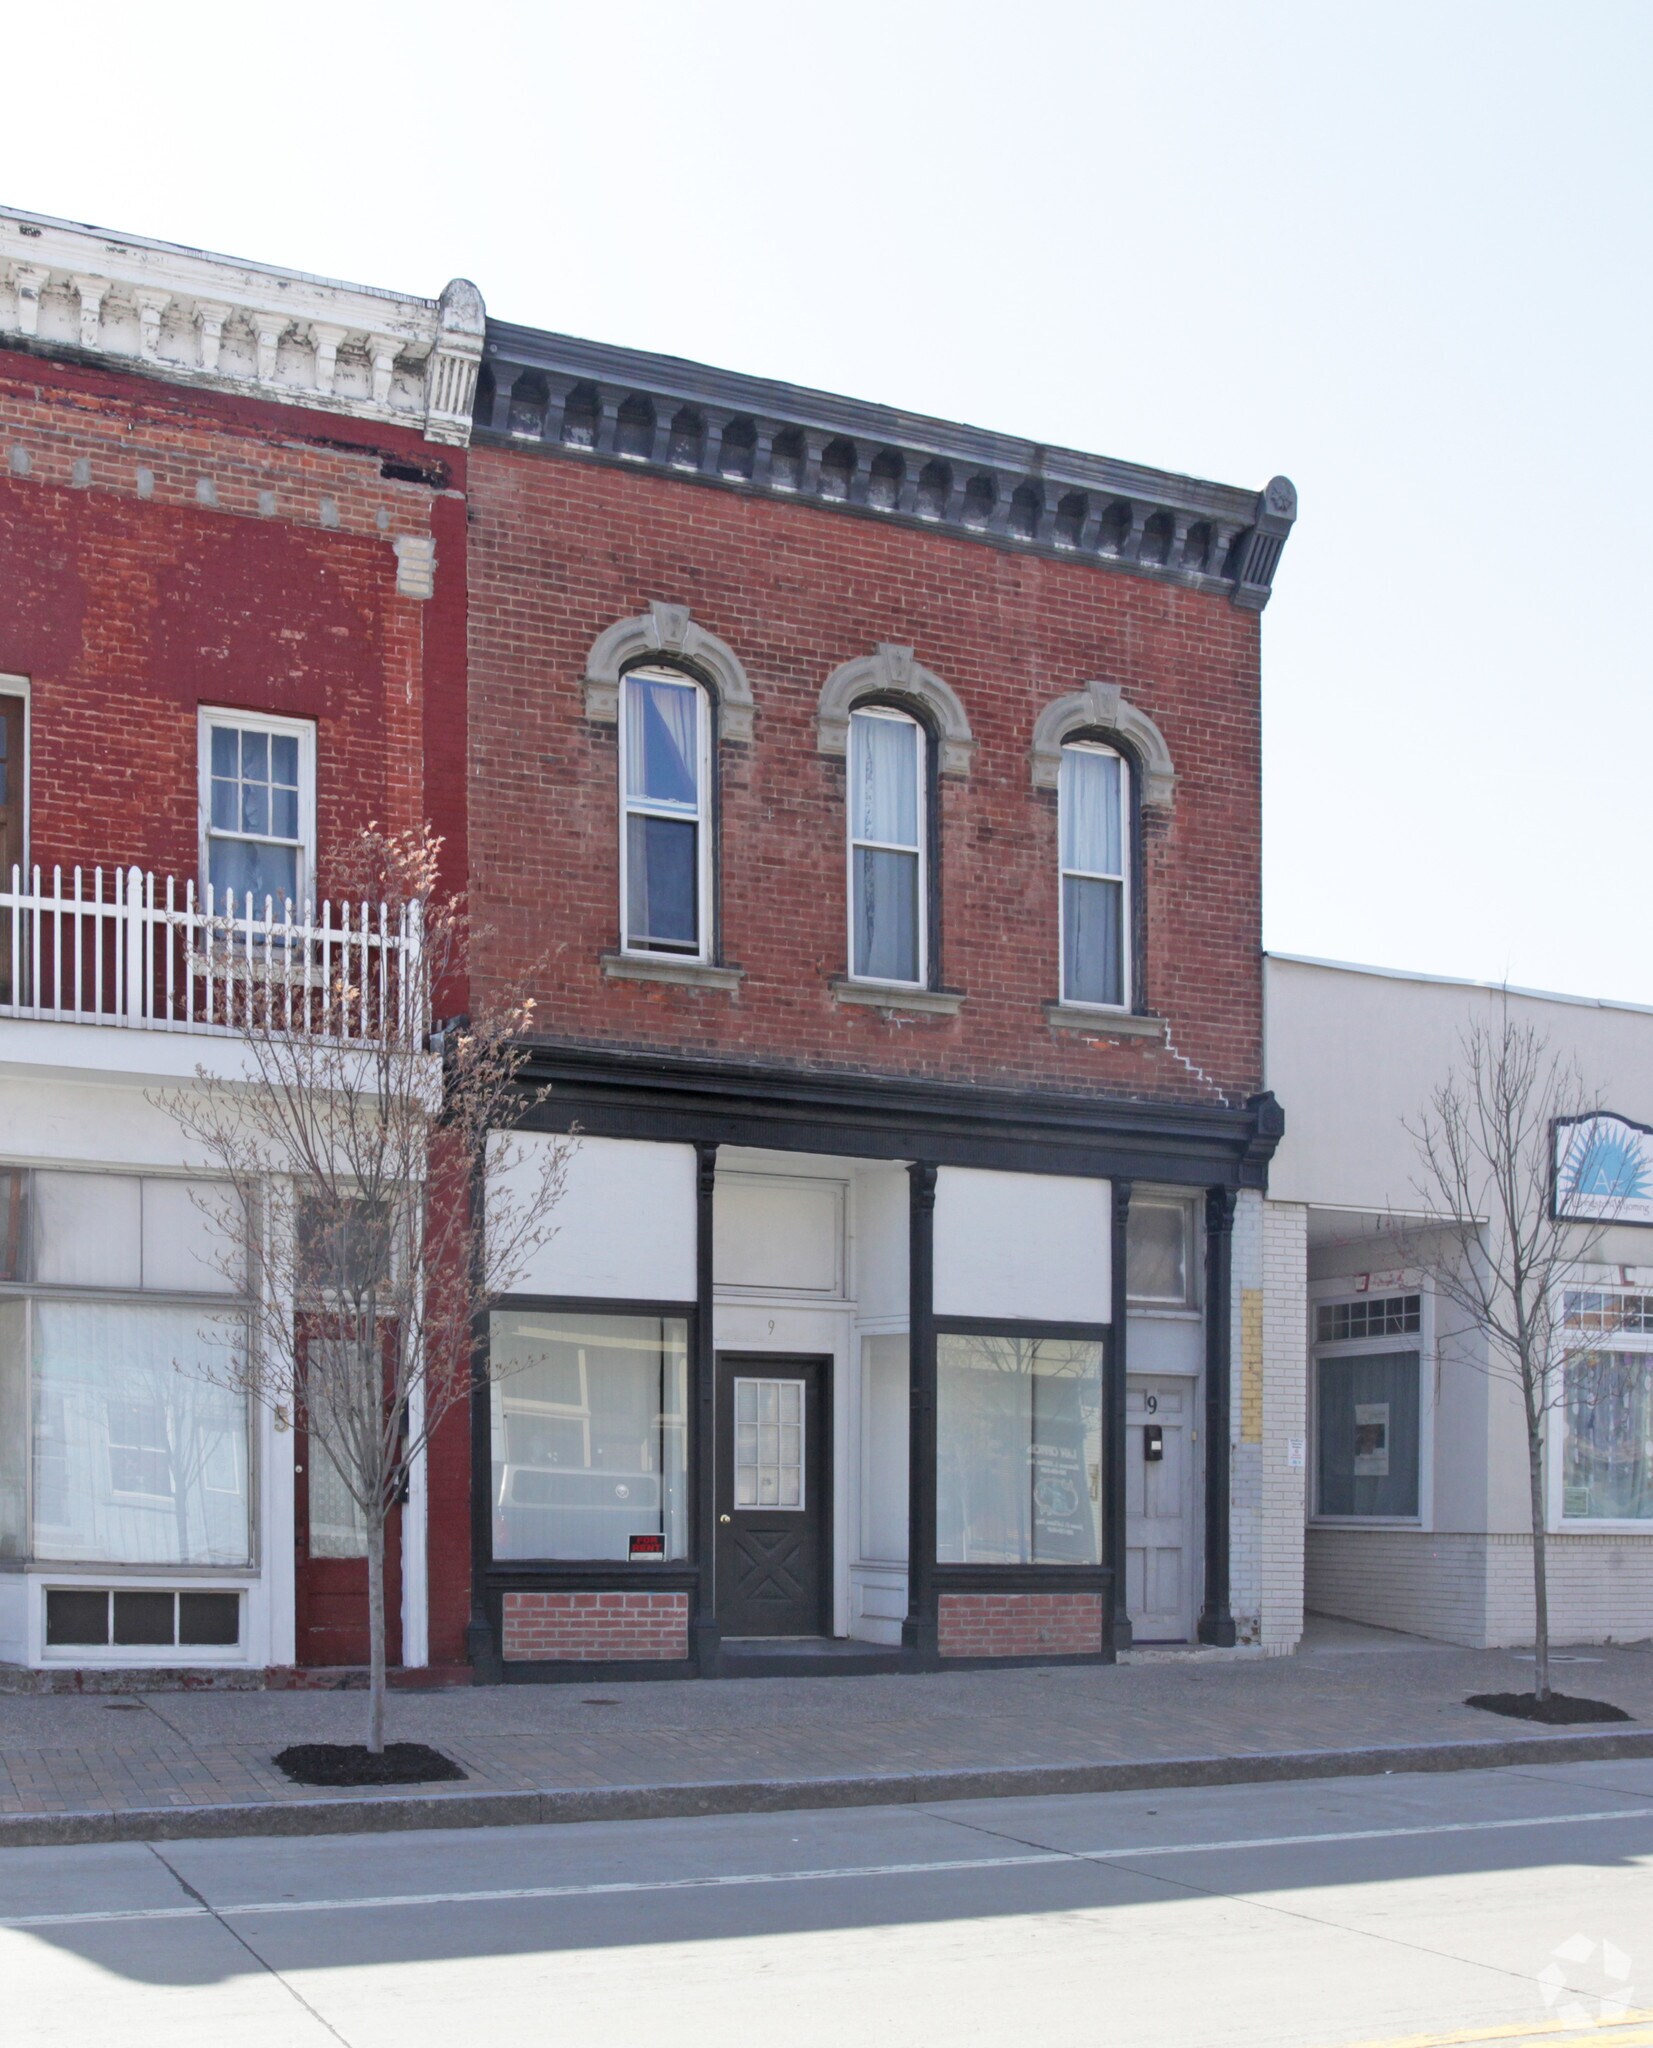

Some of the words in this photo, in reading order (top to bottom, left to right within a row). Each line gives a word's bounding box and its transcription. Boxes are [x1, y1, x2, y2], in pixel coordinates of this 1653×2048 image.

[768, 1319, 775, 1336] 9
[1147, 1395, 1158, 1415] 9
[274, 1405, 289, 1433] 5
[631, 1543, 660, 1552] RENT
[636, 1536, 657, 1544] FOR
